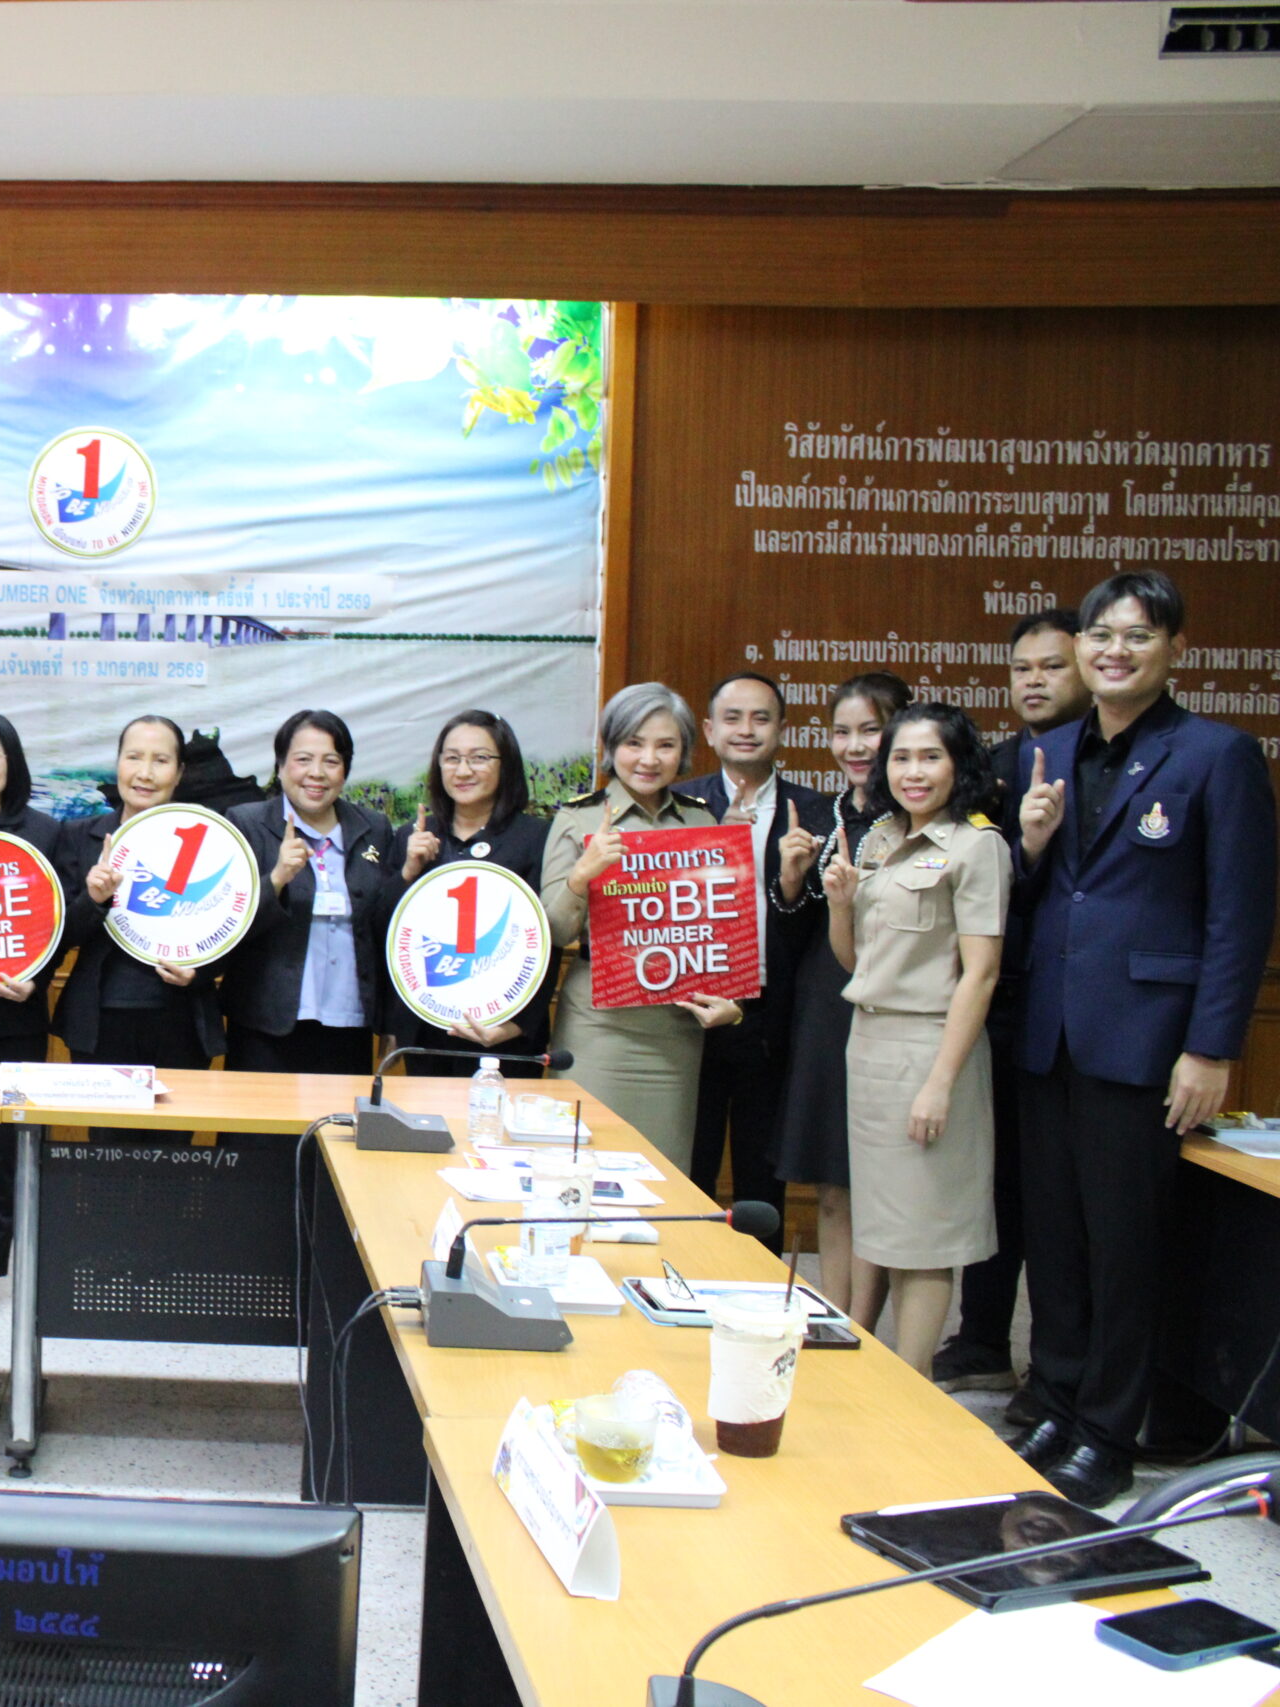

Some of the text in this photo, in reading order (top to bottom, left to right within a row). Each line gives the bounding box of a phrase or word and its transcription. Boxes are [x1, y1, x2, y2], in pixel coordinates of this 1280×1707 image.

[76, 439, 101, 499] 1
[784, 420, 1270, 478] วิสัยทัศน์การพัฒนาสุขภาพจังหวัดมุกดาหาร
[56, 585, 87, 605] ONE
[262, 592, 269, 608] 1
[337, 593, 371, 610] 2569
[72, 660, 89, 677] 19
[96, 660, 160, 678] มกราคม
[166, 662, 204, 679] 2569
[174, 822, 209, 895] 1
[621, 847, 726, 880] มุกดาหาร
[137, 886, 172, 909] BE
[447, 876, 478, 953] 1
[621, 877, 739, 922] TO BE
[156, 943, 171, 957] TO
[177, 945, 191, 958] BE
[196, 916, 237, 953] NUMBER
[232, 890, 248, 913] ONE
[623, 924, 714, 946] NUMBER
[398, 926, 421, 992] MUKDAHAN
[434, 954, 466, 977] BE
[467, 1007, 482, 1019] TO
[487, 999, 503, 1015] BE
[503, 955, 537, 1003] NUMBER
[524, 926, 538, 950] ONE
[636, 943, 730, 991] ONE
[14, 1609, 101, 1637] ๒๕๕๔
